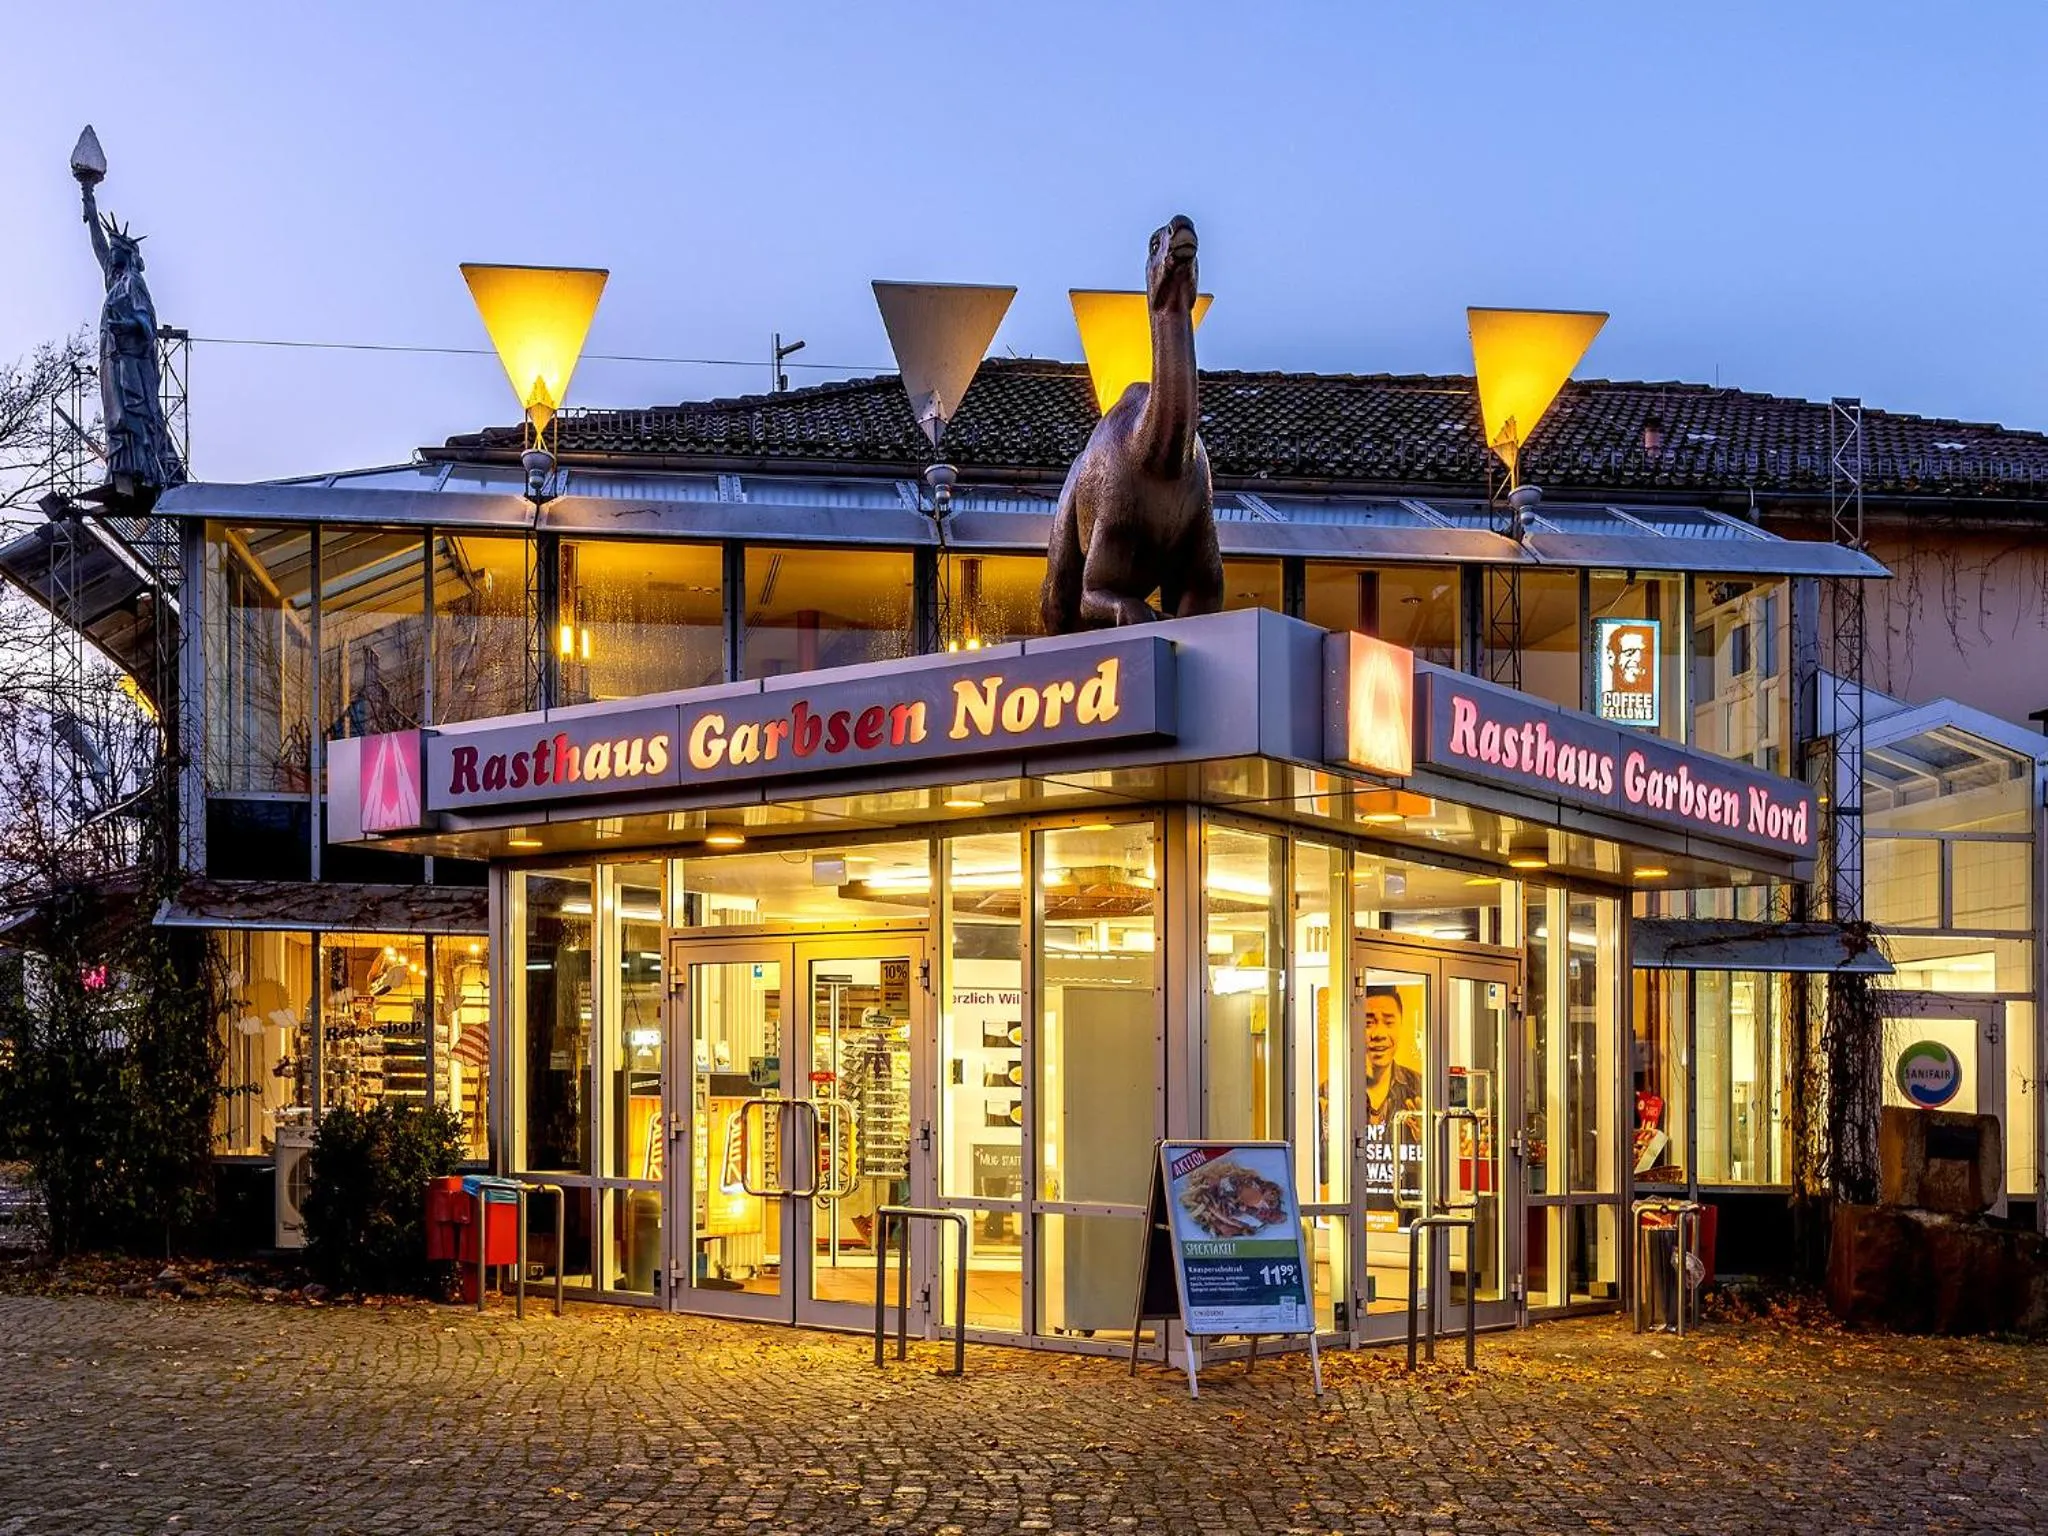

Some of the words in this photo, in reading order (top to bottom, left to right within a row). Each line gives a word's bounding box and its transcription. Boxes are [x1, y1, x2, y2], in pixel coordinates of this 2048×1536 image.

[1603, 692, 1652, 708] COFFEE
[1602, 706, 1653, 719] FELLOWS
[449, 733, 669, 794] Rasthaus
[688, 700, 928, 770] Garbsen
[949, 656, 1121, 741] Nord
[1450, 696, 1614, 795] Rasthaus
[1624, 750, 1740, 828] Garbsen
[1747, 786, 1809, 846] Nord
[326, 1020, 422, 1041] Reiseshop
[1905, 1068, 1952, 1080] SANIFAIR
[1173, 1148, 1207, 1177] AKTION
